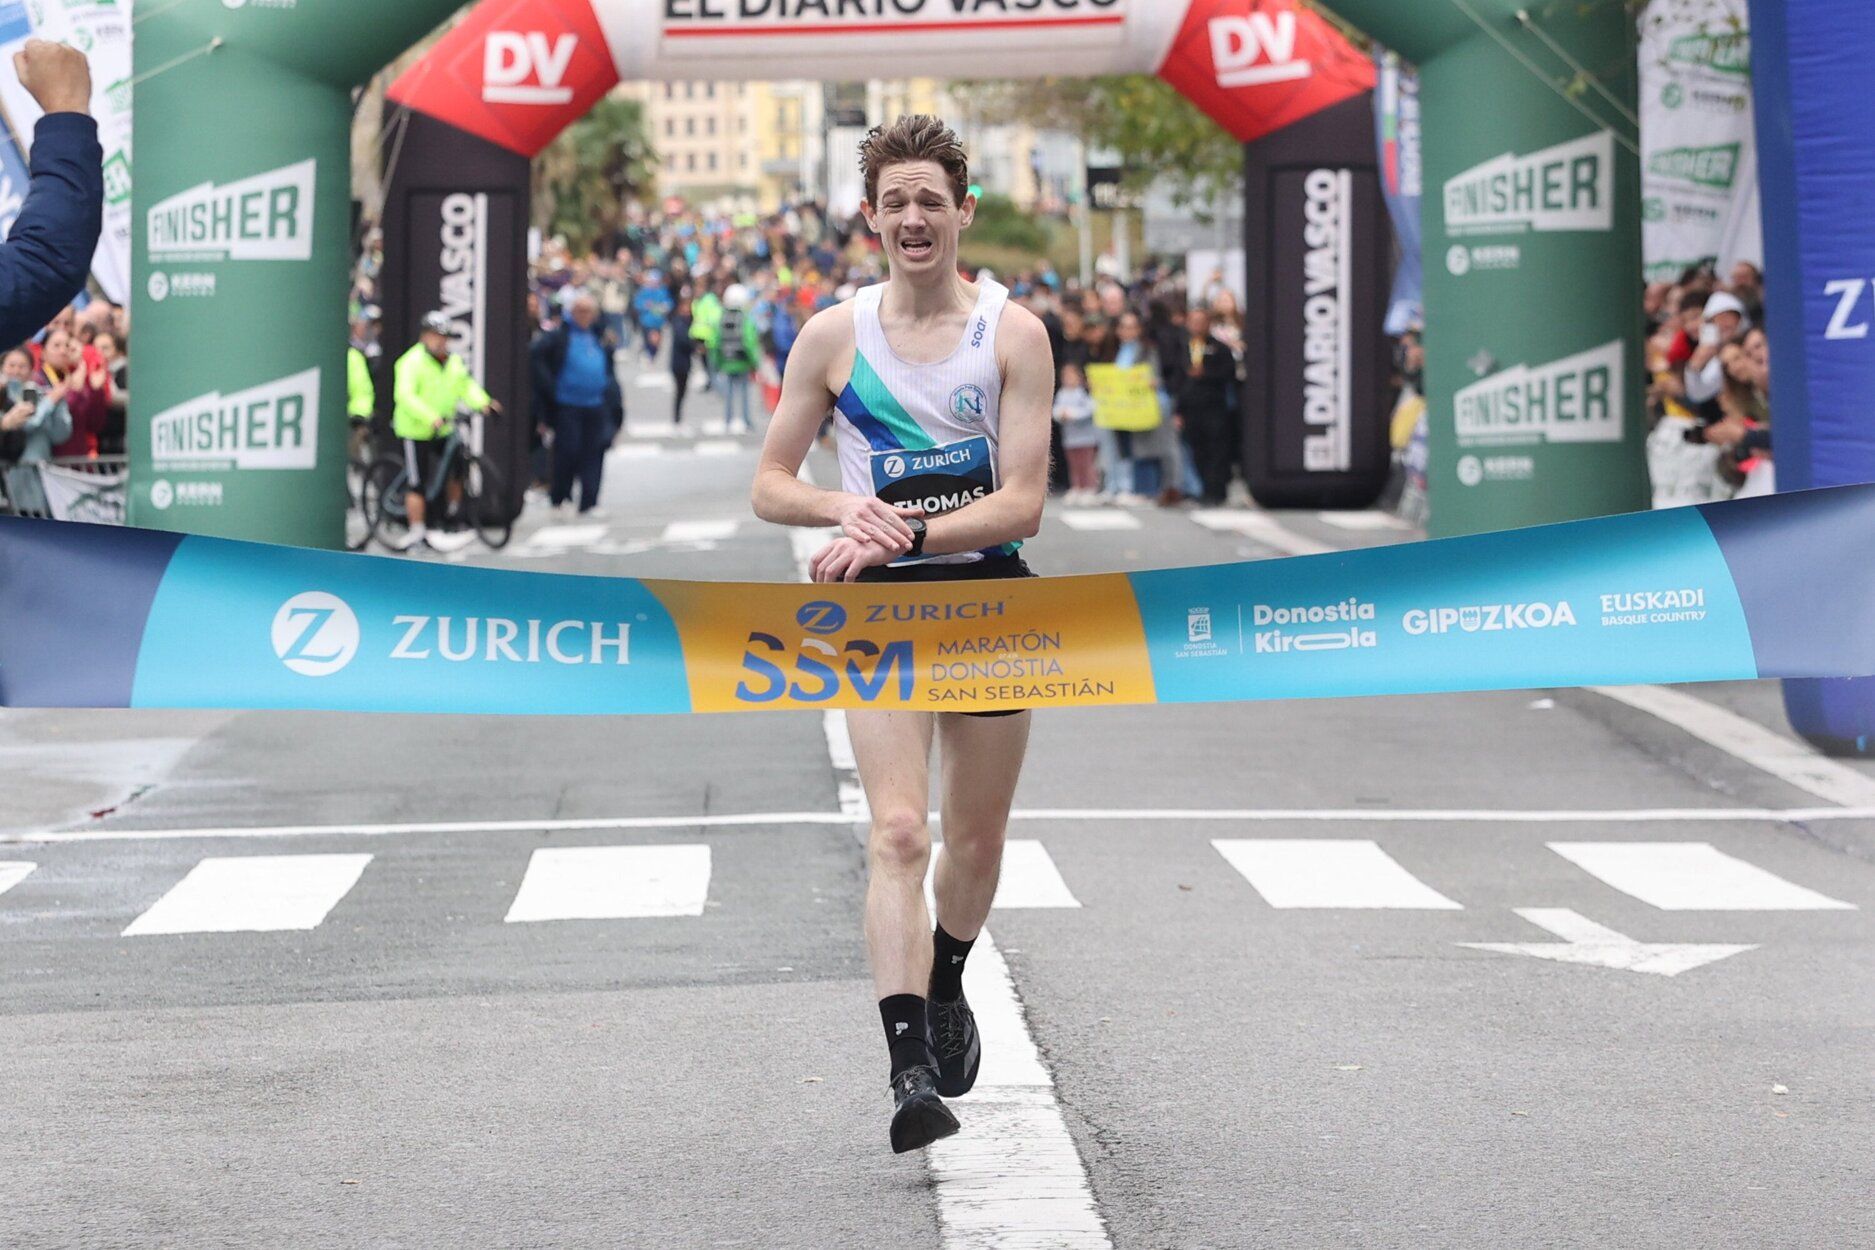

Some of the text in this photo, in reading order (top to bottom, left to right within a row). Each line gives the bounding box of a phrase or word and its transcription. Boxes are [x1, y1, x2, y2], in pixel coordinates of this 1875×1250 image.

[1207, 11, 1296, 67] DV
[484, 31, 579, 87] DV
[1450, 153, 1599, 216] FINISHER
[153, 184, 300, 243] FINISHER
[1303, 168, 1337, 297] VASCO
[1823, 278, 1875, 340] Z
[971, 315, 988, 349] soar
[1303, 296, 1336, 425] DIARIO
[1461, 365, 1610, 424] FINISHER
[157, 393, 305, 452] FINISHER
[912, 448, 972, 471] ZURICH
[893, 485, 986, 514] THOMAS
[864, 601, 1006, 623] ZURICH
[1253, 597, 1375, 626] Donostia
[1402, 601, 1577, 635] GIPUZKOA
[1600, 588, 1705, 614] EUSKADI
[1601, 611, 1706, 626] BASQUE COUNTRY
[388, 614, 631, 665] ZURICH
[937, 628, 1062, 657] MARATÓN
[1255, 626, 1377, 654] Kirola
[931, 658, 1064, 682] DONOSTIA
[928, 678, 1115, 702] SAN SEBASTIÁN
